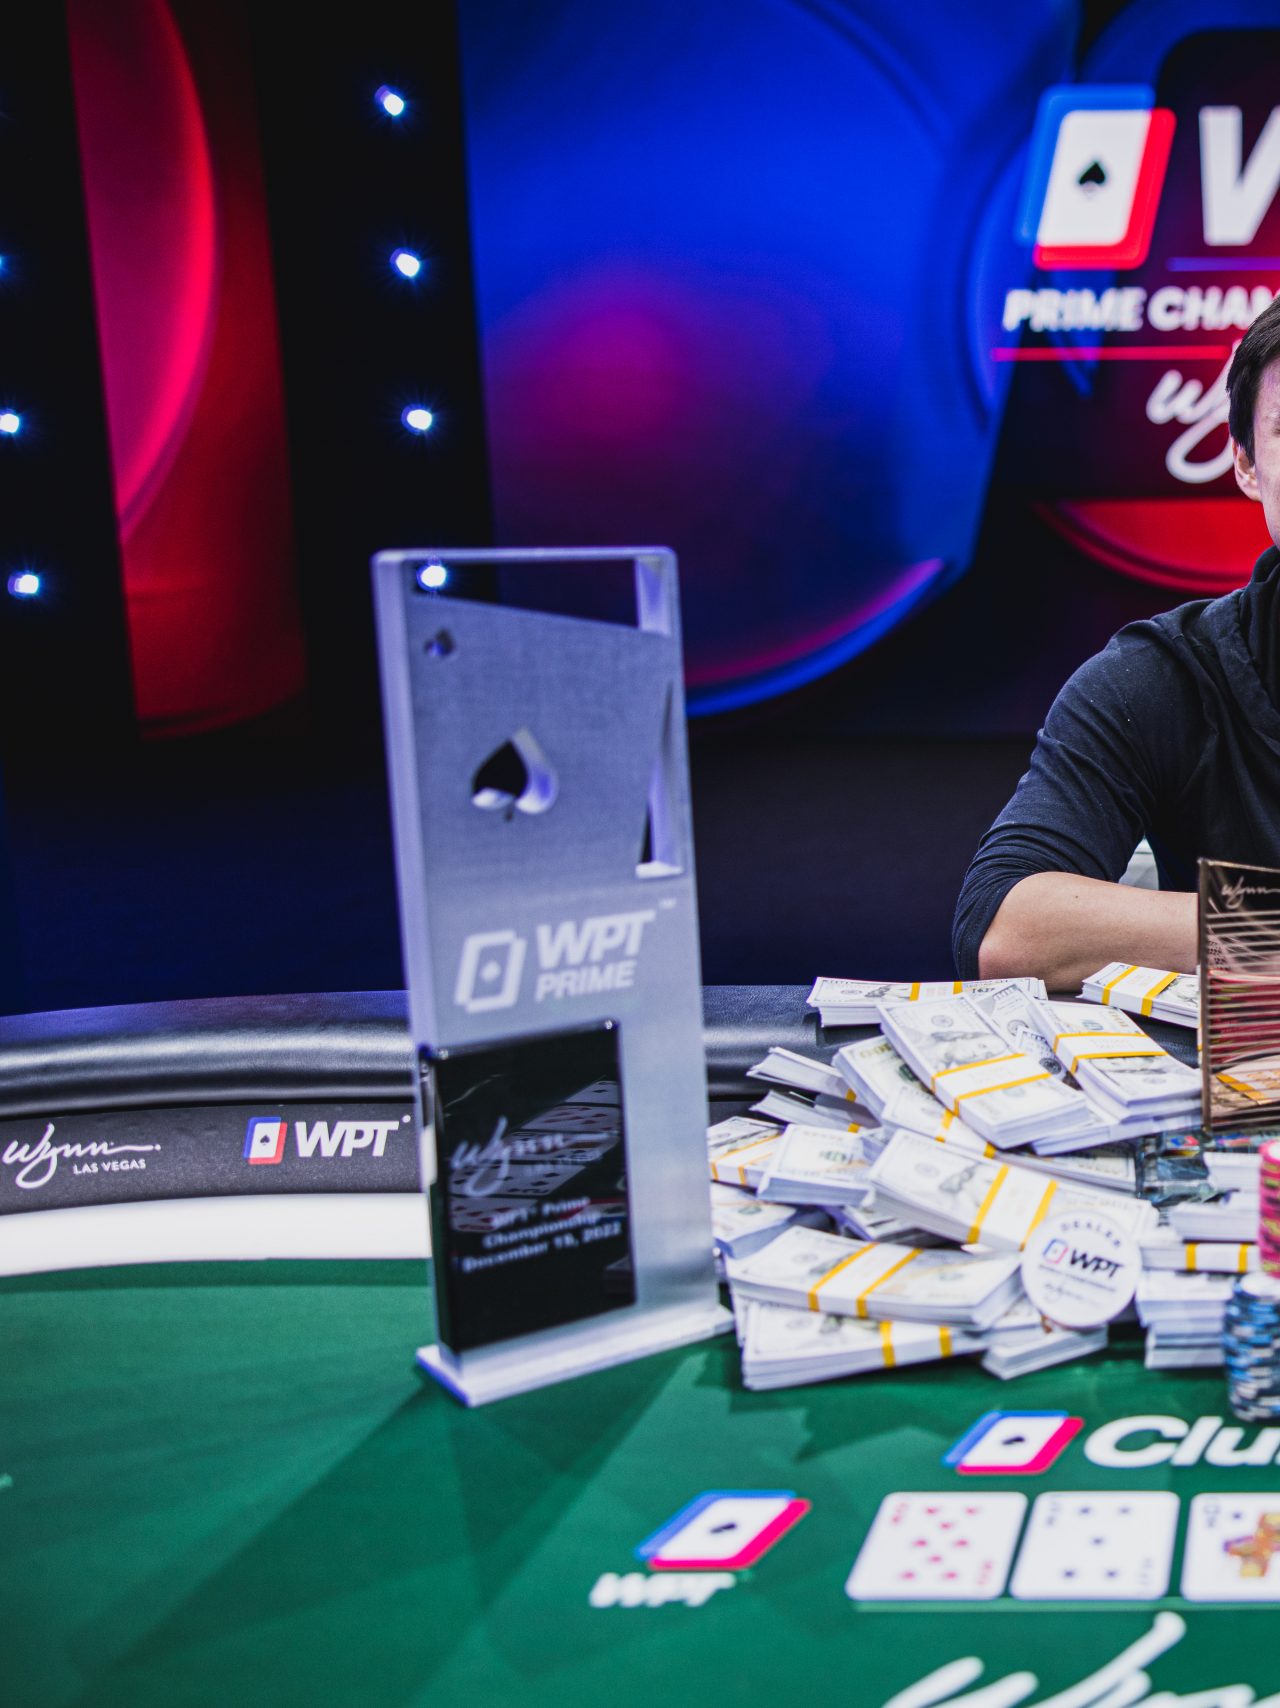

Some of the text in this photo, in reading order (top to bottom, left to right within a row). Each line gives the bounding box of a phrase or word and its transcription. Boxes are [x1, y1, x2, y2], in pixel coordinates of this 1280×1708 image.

[1002, 288, 1146, 332] PRIME
[536, 909, 657, 970] WPT
[535, 960, 637, 1003] PRIME
[2, 1122, 162, 1189] Wynn
[295, 1121, 400, 1157] WPT
[73, 1158, 147, 1175] LAS VEGAS
[463, 1242, 549, 1273] December
[1070, 1249, 1124, 1278] WPT
